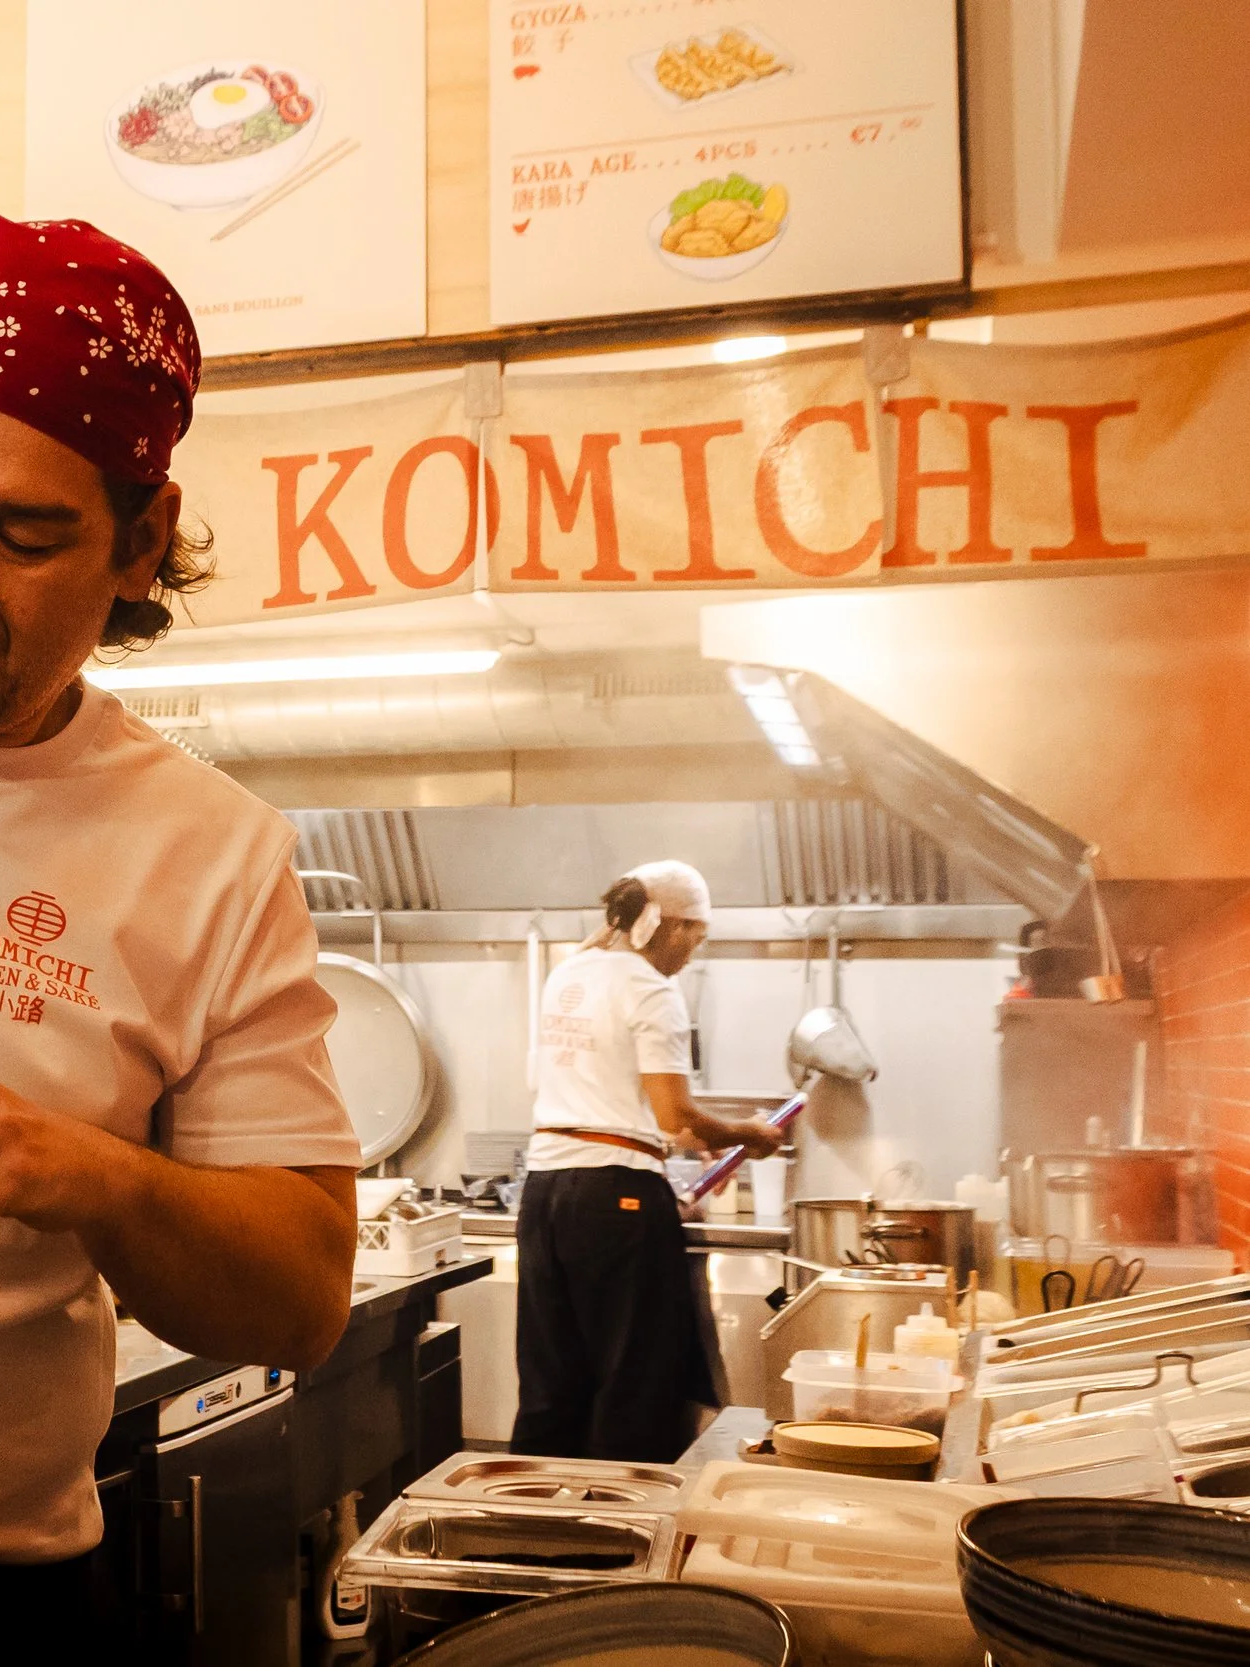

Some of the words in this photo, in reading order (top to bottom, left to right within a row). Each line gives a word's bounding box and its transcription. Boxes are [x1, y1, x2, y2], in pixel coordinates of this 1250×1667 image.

[511, 4, 586, 30] GYOZA
[512, 160, 573, 184] KARA
[590, 152, 636, 177] AGE
[233, 295, 304, 313] BOUILLON
[261, 397, 1148, 609] KOMICHI
[24, 973, 41, 991] &
